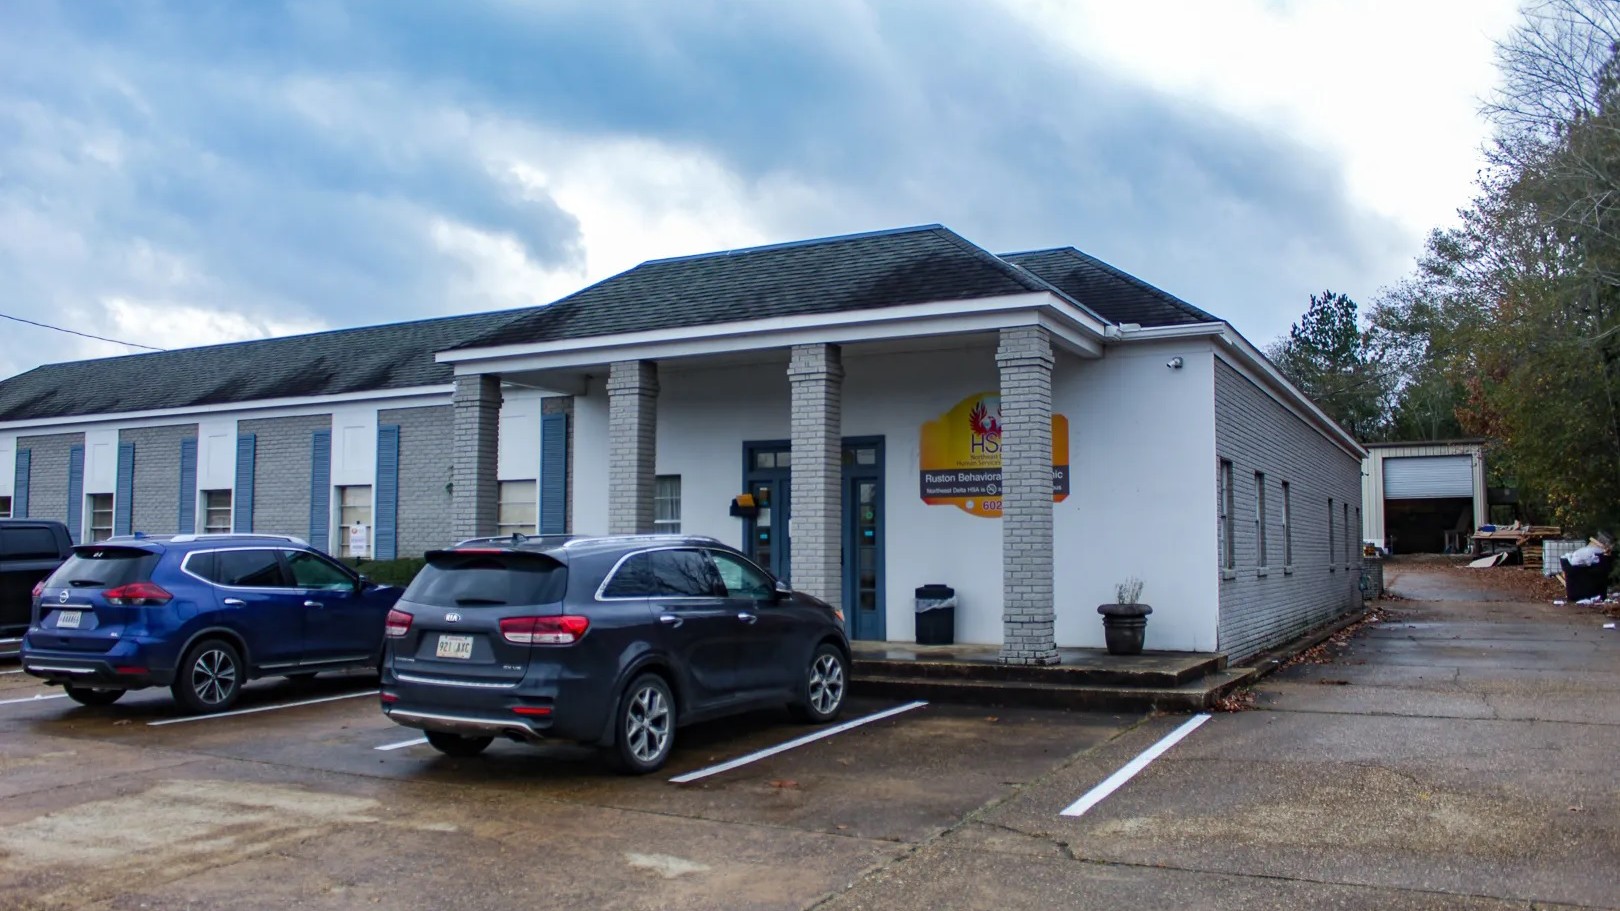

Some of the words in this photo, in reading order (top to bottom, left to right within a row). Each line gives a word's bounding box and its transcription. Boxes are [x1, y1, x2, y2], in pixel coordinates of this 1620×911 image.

[971, 432, 1002, 453] HS
[925, 474, 956, 483] Ruston
[958, 472, 1002, 482] Behaviora
